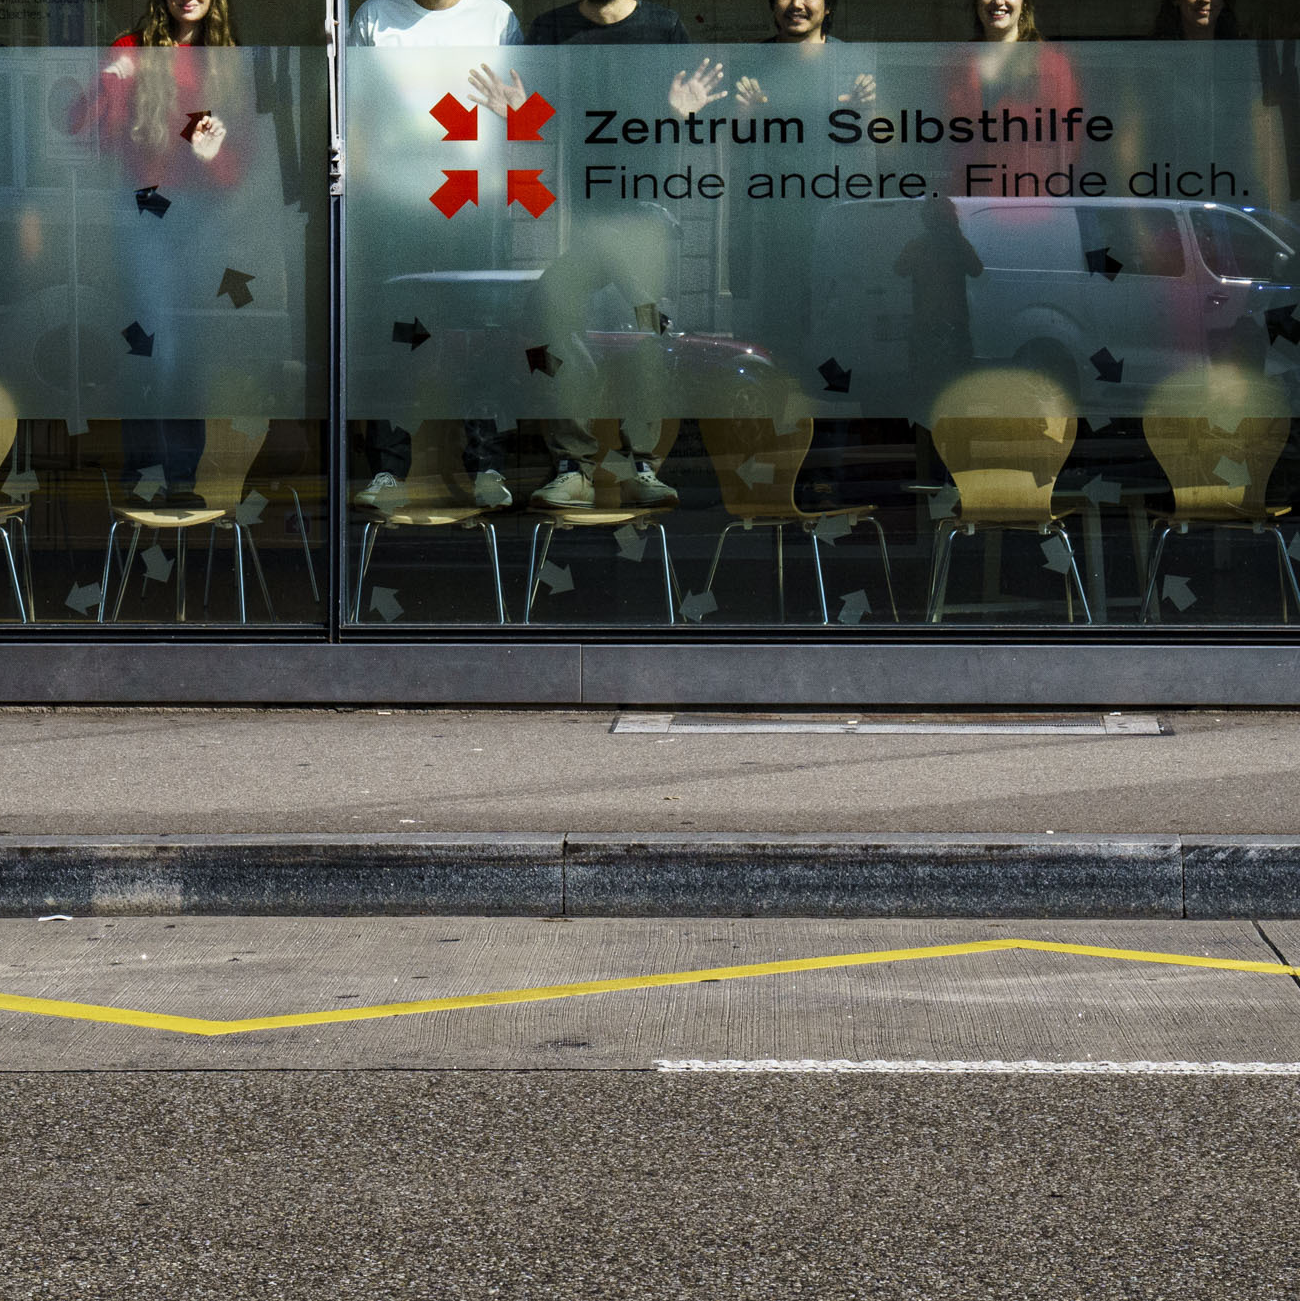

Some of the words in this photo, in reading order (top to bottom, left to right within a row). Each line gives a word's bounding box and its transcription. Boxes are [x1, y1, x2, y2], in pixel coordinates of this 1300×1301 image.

[583, 110, 806, 145] Zentrum
[827, 107, 1115, 144] Selbsthilfe
[584, 165, 726, 199] Finde
[747, 166, 940, 199] andere.
[965, 164, 1108, 198] Finde
[1128, 162, 1250, 197] dich.
